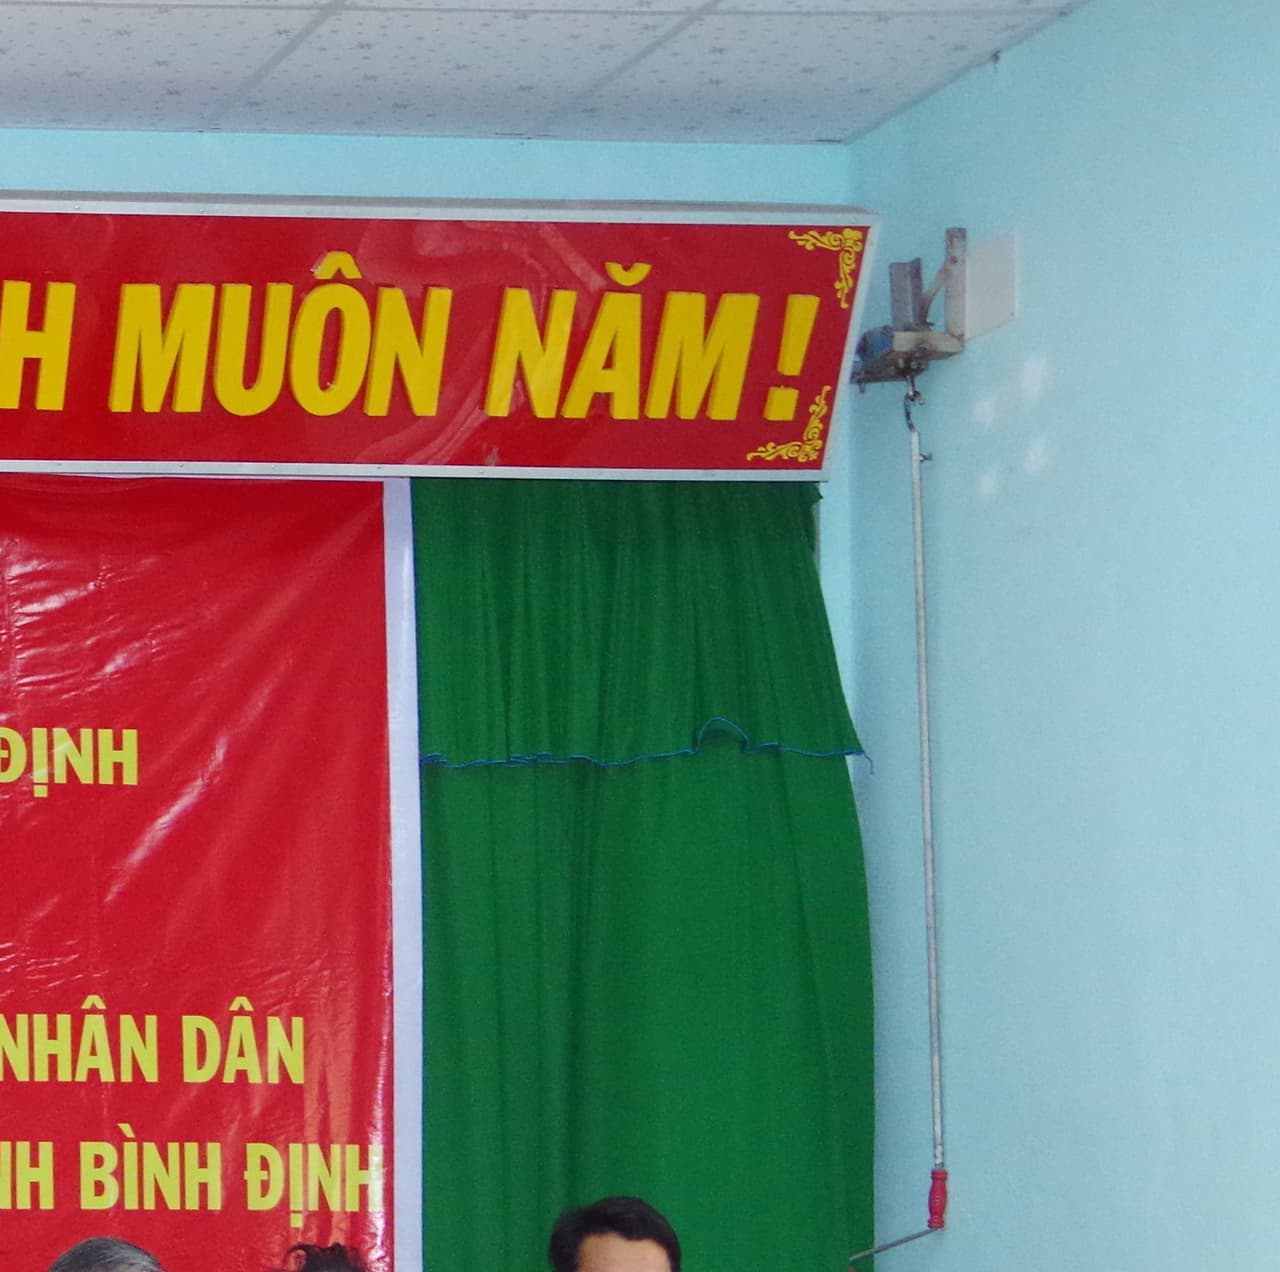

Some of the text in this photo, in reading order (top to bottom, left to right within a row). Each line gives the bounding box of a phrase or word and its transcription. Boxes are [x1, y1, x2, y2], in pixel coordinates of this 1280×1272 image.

[108, 250, 453, 417] MUÔN
[181, 996, 306, 1085] DÂN
[79, 1122, 224, 1212] BÌNH
[244, 1141, 385, 1228] ĐỊNH
